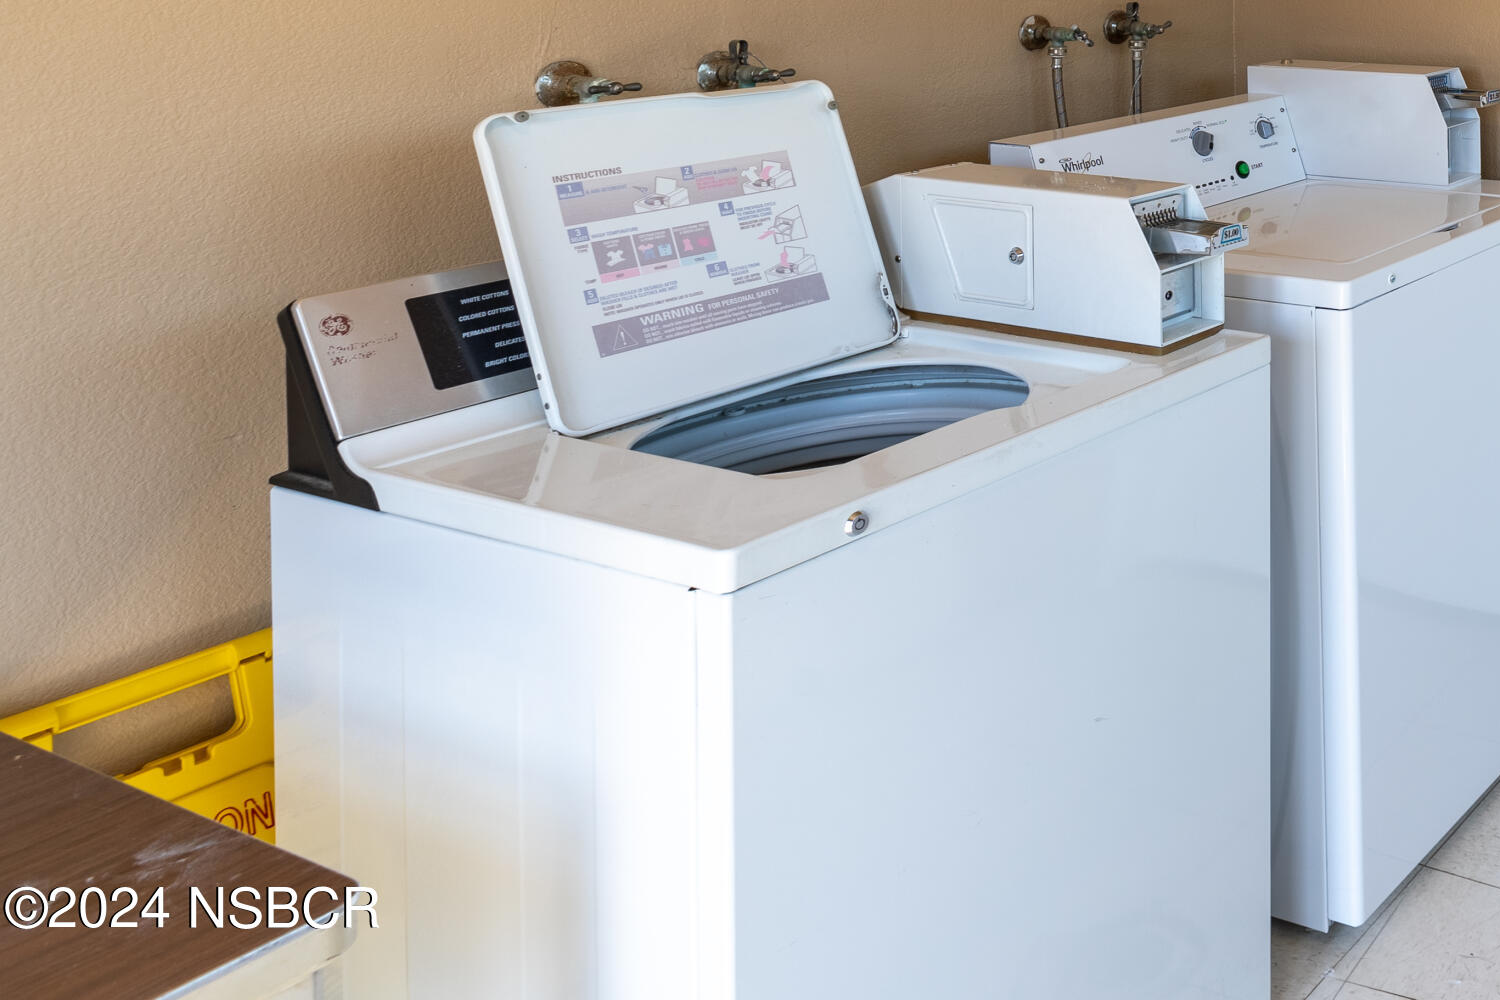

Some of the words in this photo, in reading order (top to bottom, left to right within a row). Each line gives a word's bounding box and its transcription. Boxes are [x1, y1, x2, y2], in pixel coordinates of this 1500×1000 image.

[1061, 154, 1104, 173] Whirlpool
[552, 166, 623, 183] INSTRUCTIONS
[1224, 227, 1240, 239] $1.00
[460, 295, 481, 305] WHITE
[481, 289, 510, 300] COTTONS
[458, 311, 487, 322] COLORED
[487, 304, 515, 315] COTTONS
[640, 303, 705, 326] WARNING
[708, 301, 721, 311] FOR
[721, 293, 755, 308] PERSONAL
[755, 287, 779, 301] SAFETY
[462, 324, 501, 339] PERMANENT
[501, 320, 520, 329] PRESS
[484, 356, 508, 368] BRIGHT
[508, 352, 529, 361] COLOR
